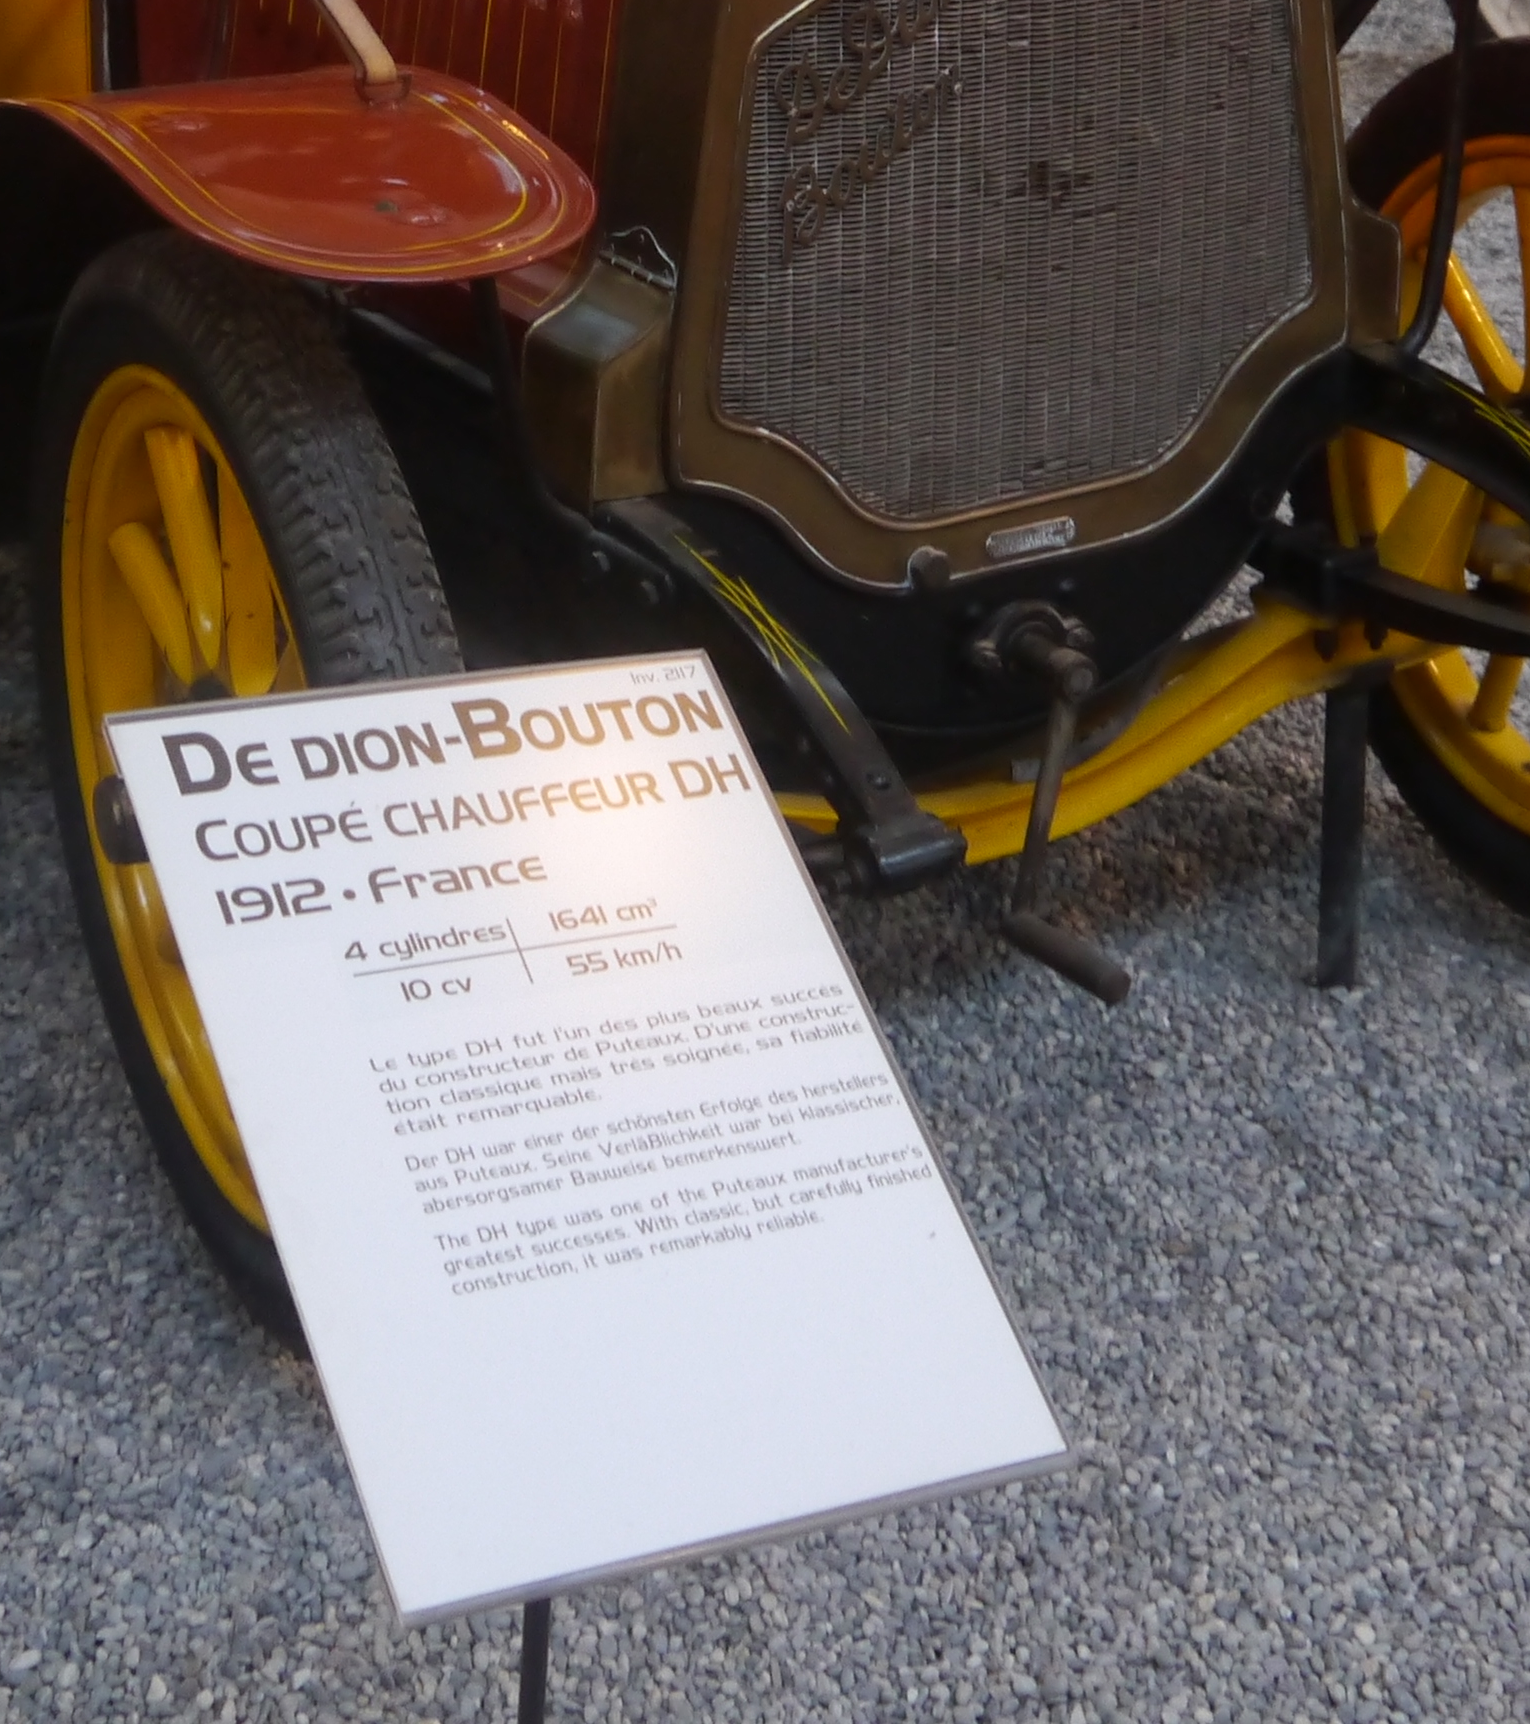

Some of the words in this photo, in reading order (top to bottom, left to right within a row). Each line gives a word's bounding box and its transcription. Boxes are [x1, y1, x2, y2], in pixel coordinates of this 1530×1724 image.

[195, 801, 373, 862] COUPÉ
[383, 772, 664, 837] CHAUFFEUR
[669, 753, 750, 799] DH
[215, 877, 332, 926] 1912
[368, 856, 547, 905] France
[548, 905, 607, 931] 1641
[344, 940, 368, 961] 4
[379, 925, 507, 961] cylindres
[566, 951, 608, 976] 55
[613, 941, 682, 968] km/h
[400, 979, 432, 1002] 10
[441, 977, 471, 995] cv
[369, 1058, 397, 1073] Le
[407, 1049, 457, 1068] type
[465, 1037, 503, 1057] DH
[513, 1031, 546, 1049] fut
[553, 1027, 590, 1042] l'un
[600, 1019, 638, 1034] des
[646, 1011, 690, 1030] plus
[697, 998, 762, 1018] beaux
[379, 1078, 407, 1093] du
[415, 1054, 554, 1087] constructeur
[564, 1047, 589, 1061] de
[595, 1032, 689, 1056] Puteaux.
[693, 1022, 751, 1040] D'une
[759, 1005, 854, 1028] construc-
[386, 1097, 431, 1114] tion
[440, 1078, 542, 1105] classique
[550, 1066, 601, 1085] mais
[663, 1043, 749, 1066] soignée,
[756, 1037, 783, 1050] sa
[790, 1019, 863, 1044] fiabilité
[394, 1113, 448, 1135] était
[456, 1088, 601, 1125] remarquable.
[405, 1155, 438, 1172] Der
[445, 1145, 475, 1164] DH
[482, 1142, 516, 1157] war
[524, 1133, 564, 1149] einer
[572, 1126, 599, 1141] der
[607, 1109, 695, 1135] schönsten
[699, 1097, 762, 1117] Erfolge
[768, 1090, 798, 1105] des
[801, 1075, 888, 1098] herstellers
[415, 1177, 448, 1192] aus
[454, 1161, 537, 1185] Puteaux.
[542, 1150, 592, 1169] Seine
[729, 1118, 761, 1134] war
[768, 1110, 794, 1127] bei
[423, 1178, 563, 1214] abersorgsamer
[570, 1161, 656, 1186] Bauweise
[662, 1133, 800, 1169] bemerkenswert.
[434, 1234, 470, 1251] The
[476, 1223, 508, 1243] DH
[516, 1218, 557, 1237] type
[564, 1209, 603, 1226] was
[610, 1201, 643, 1217] one
[650, 1192, 669, 1209] of
[678, 1188, 707, 1206] the
[712, 1173, 787, 1197] Puteaux
[793, 1145, 923, 1181] manufacturer's
[444, 1244, 524, 1276] greatest
[531, 1227, 630, 1256] successes.
[634, 1215, 678, 1235] With
[685, 1202, 749, 1225] classic,
[752, 1193, 783, 1212] but
[789, 1179, 862, 1204] carefully
[867, 1163, 932, 1188] finished
[452, 1261, 578, 1295] construction,
[582, 1252, 598, 1268] it
[604, 1247, 643, 1265] was
[650, 1223, 752, 1255] remarkably
[757, 1210, 822, 1234] reliable.
